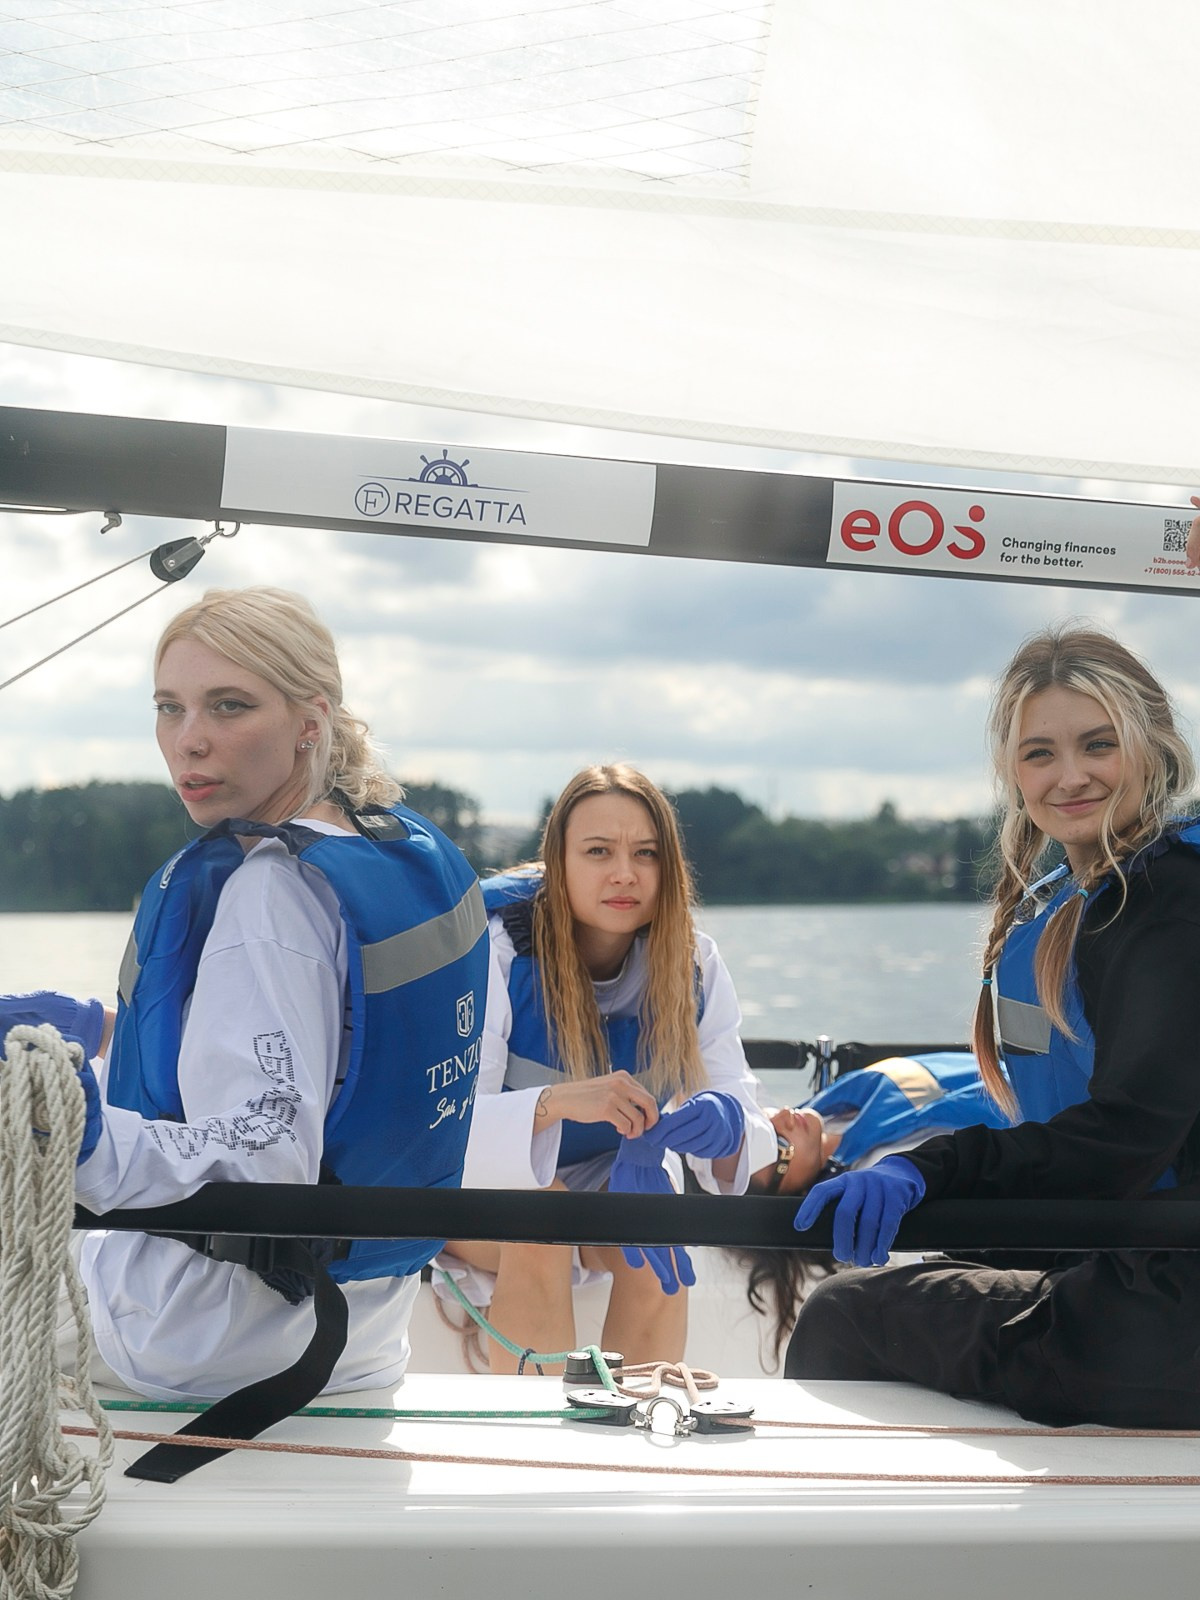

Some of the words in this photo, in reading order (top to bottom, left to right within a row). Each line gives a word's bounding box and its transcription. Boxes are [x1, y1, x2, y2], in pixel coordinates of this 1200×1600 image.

[394, 492, 528, 526] REGATTA
[1001, 537, 1062, 553] Changing
[1064, 541, 1117, 555] finances
[1000, 552, 1018, 563] for
[1021, 553, 1041, 565] the
[1043, 555, 1084, 568] better.
[1172, 568, 1200, 577] 555-62-
[426, 1036, 482, 1094] TENZO
